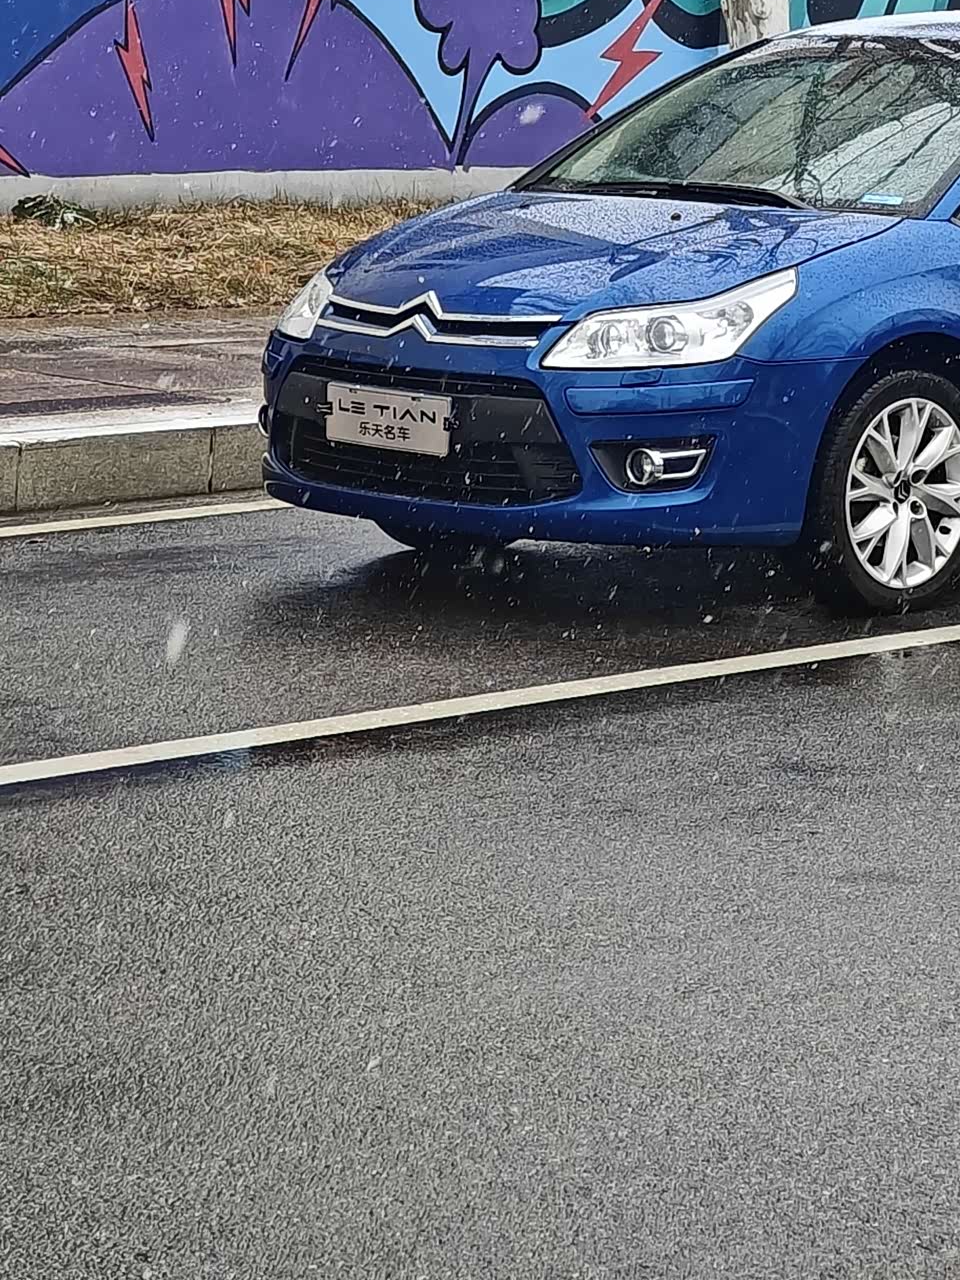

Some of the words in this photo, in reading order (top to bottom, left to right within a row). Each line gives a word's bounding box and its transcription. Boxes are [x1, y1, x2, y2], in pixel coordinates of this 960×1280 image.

[338, 398, 366, 415] LE
[373, 404, 437, 424] TIAN
[358, 421, 411, 442] 乐天名车
